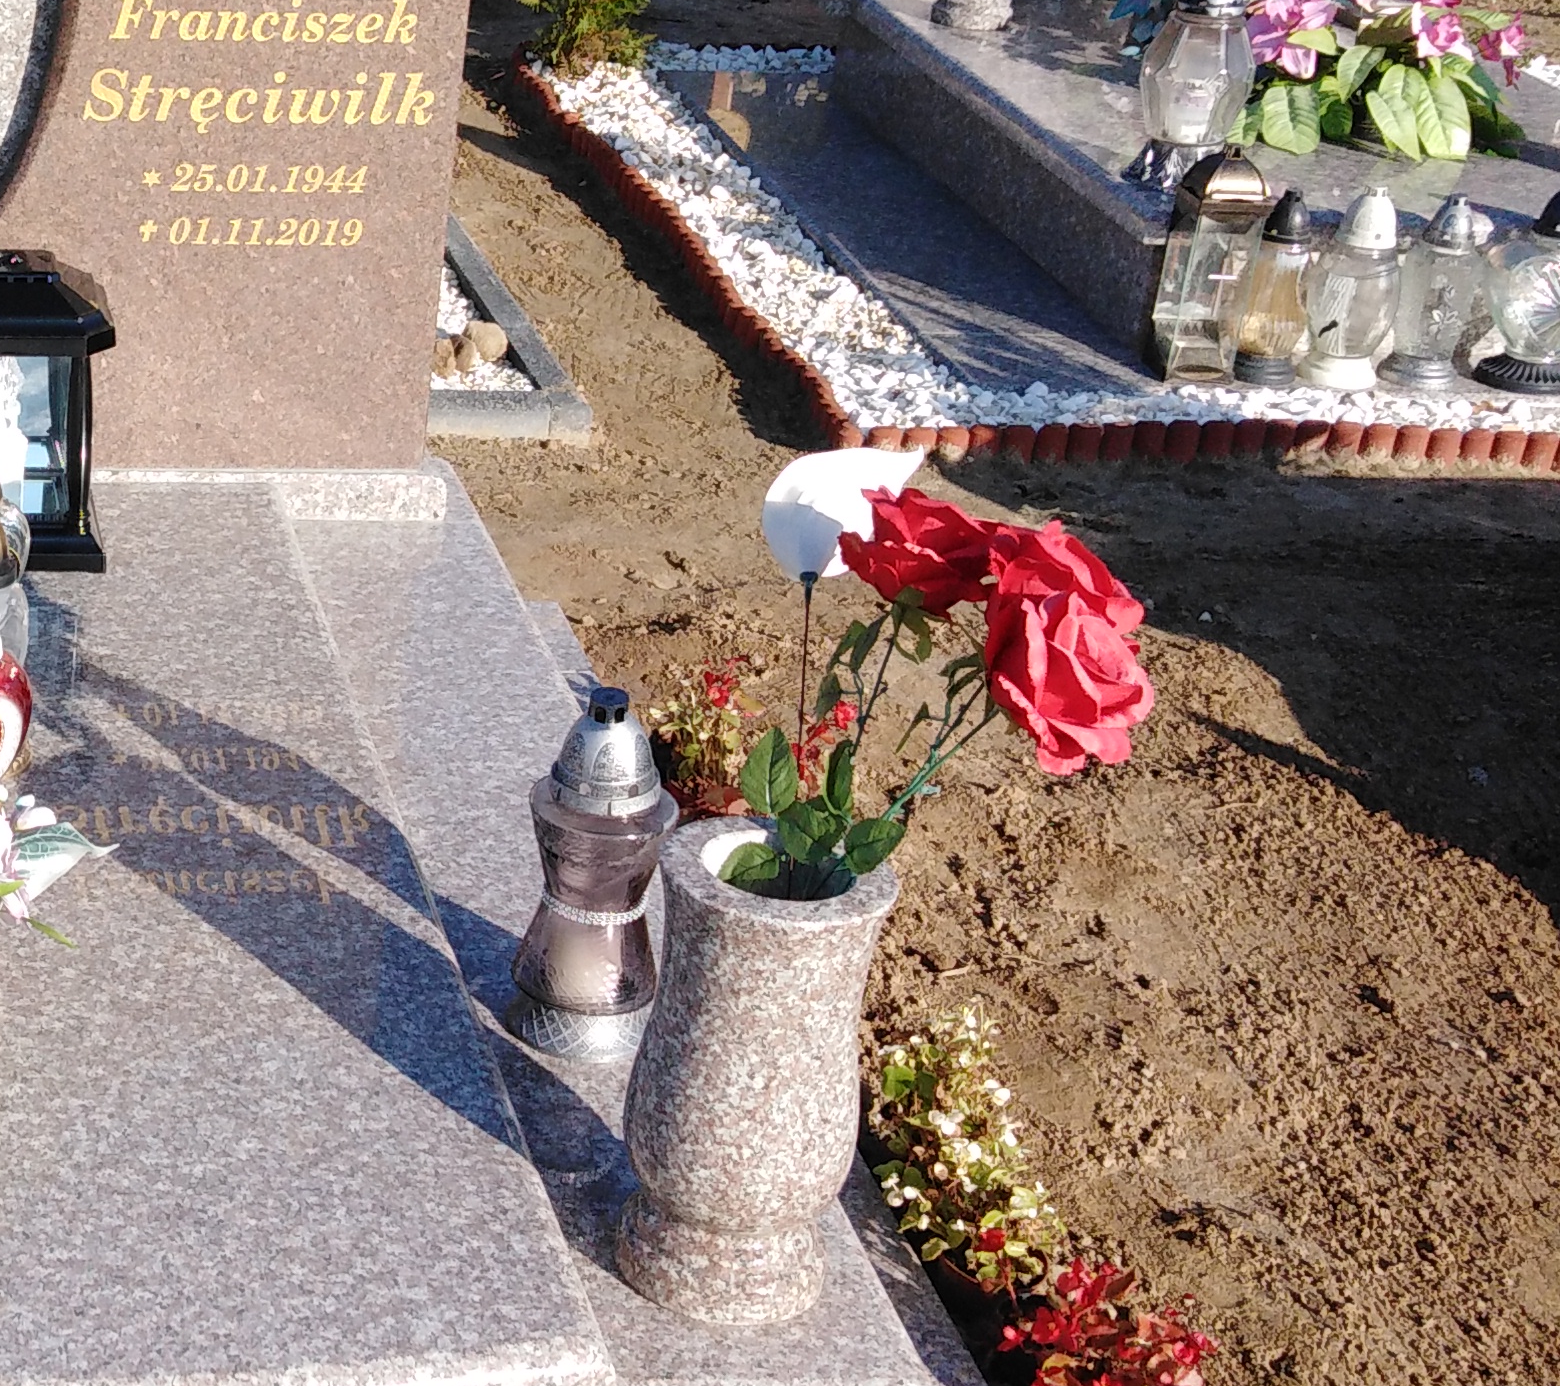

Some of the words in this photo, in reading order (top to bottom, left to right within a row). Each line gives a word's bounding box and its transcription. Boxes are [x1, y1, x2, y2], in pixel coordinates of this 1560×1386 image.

[82, 67, 436, 134] Stręciwilk
[169, 162, 369, 195] 25.01.1944
[168, 216, 365, 247] 01.11.2019
